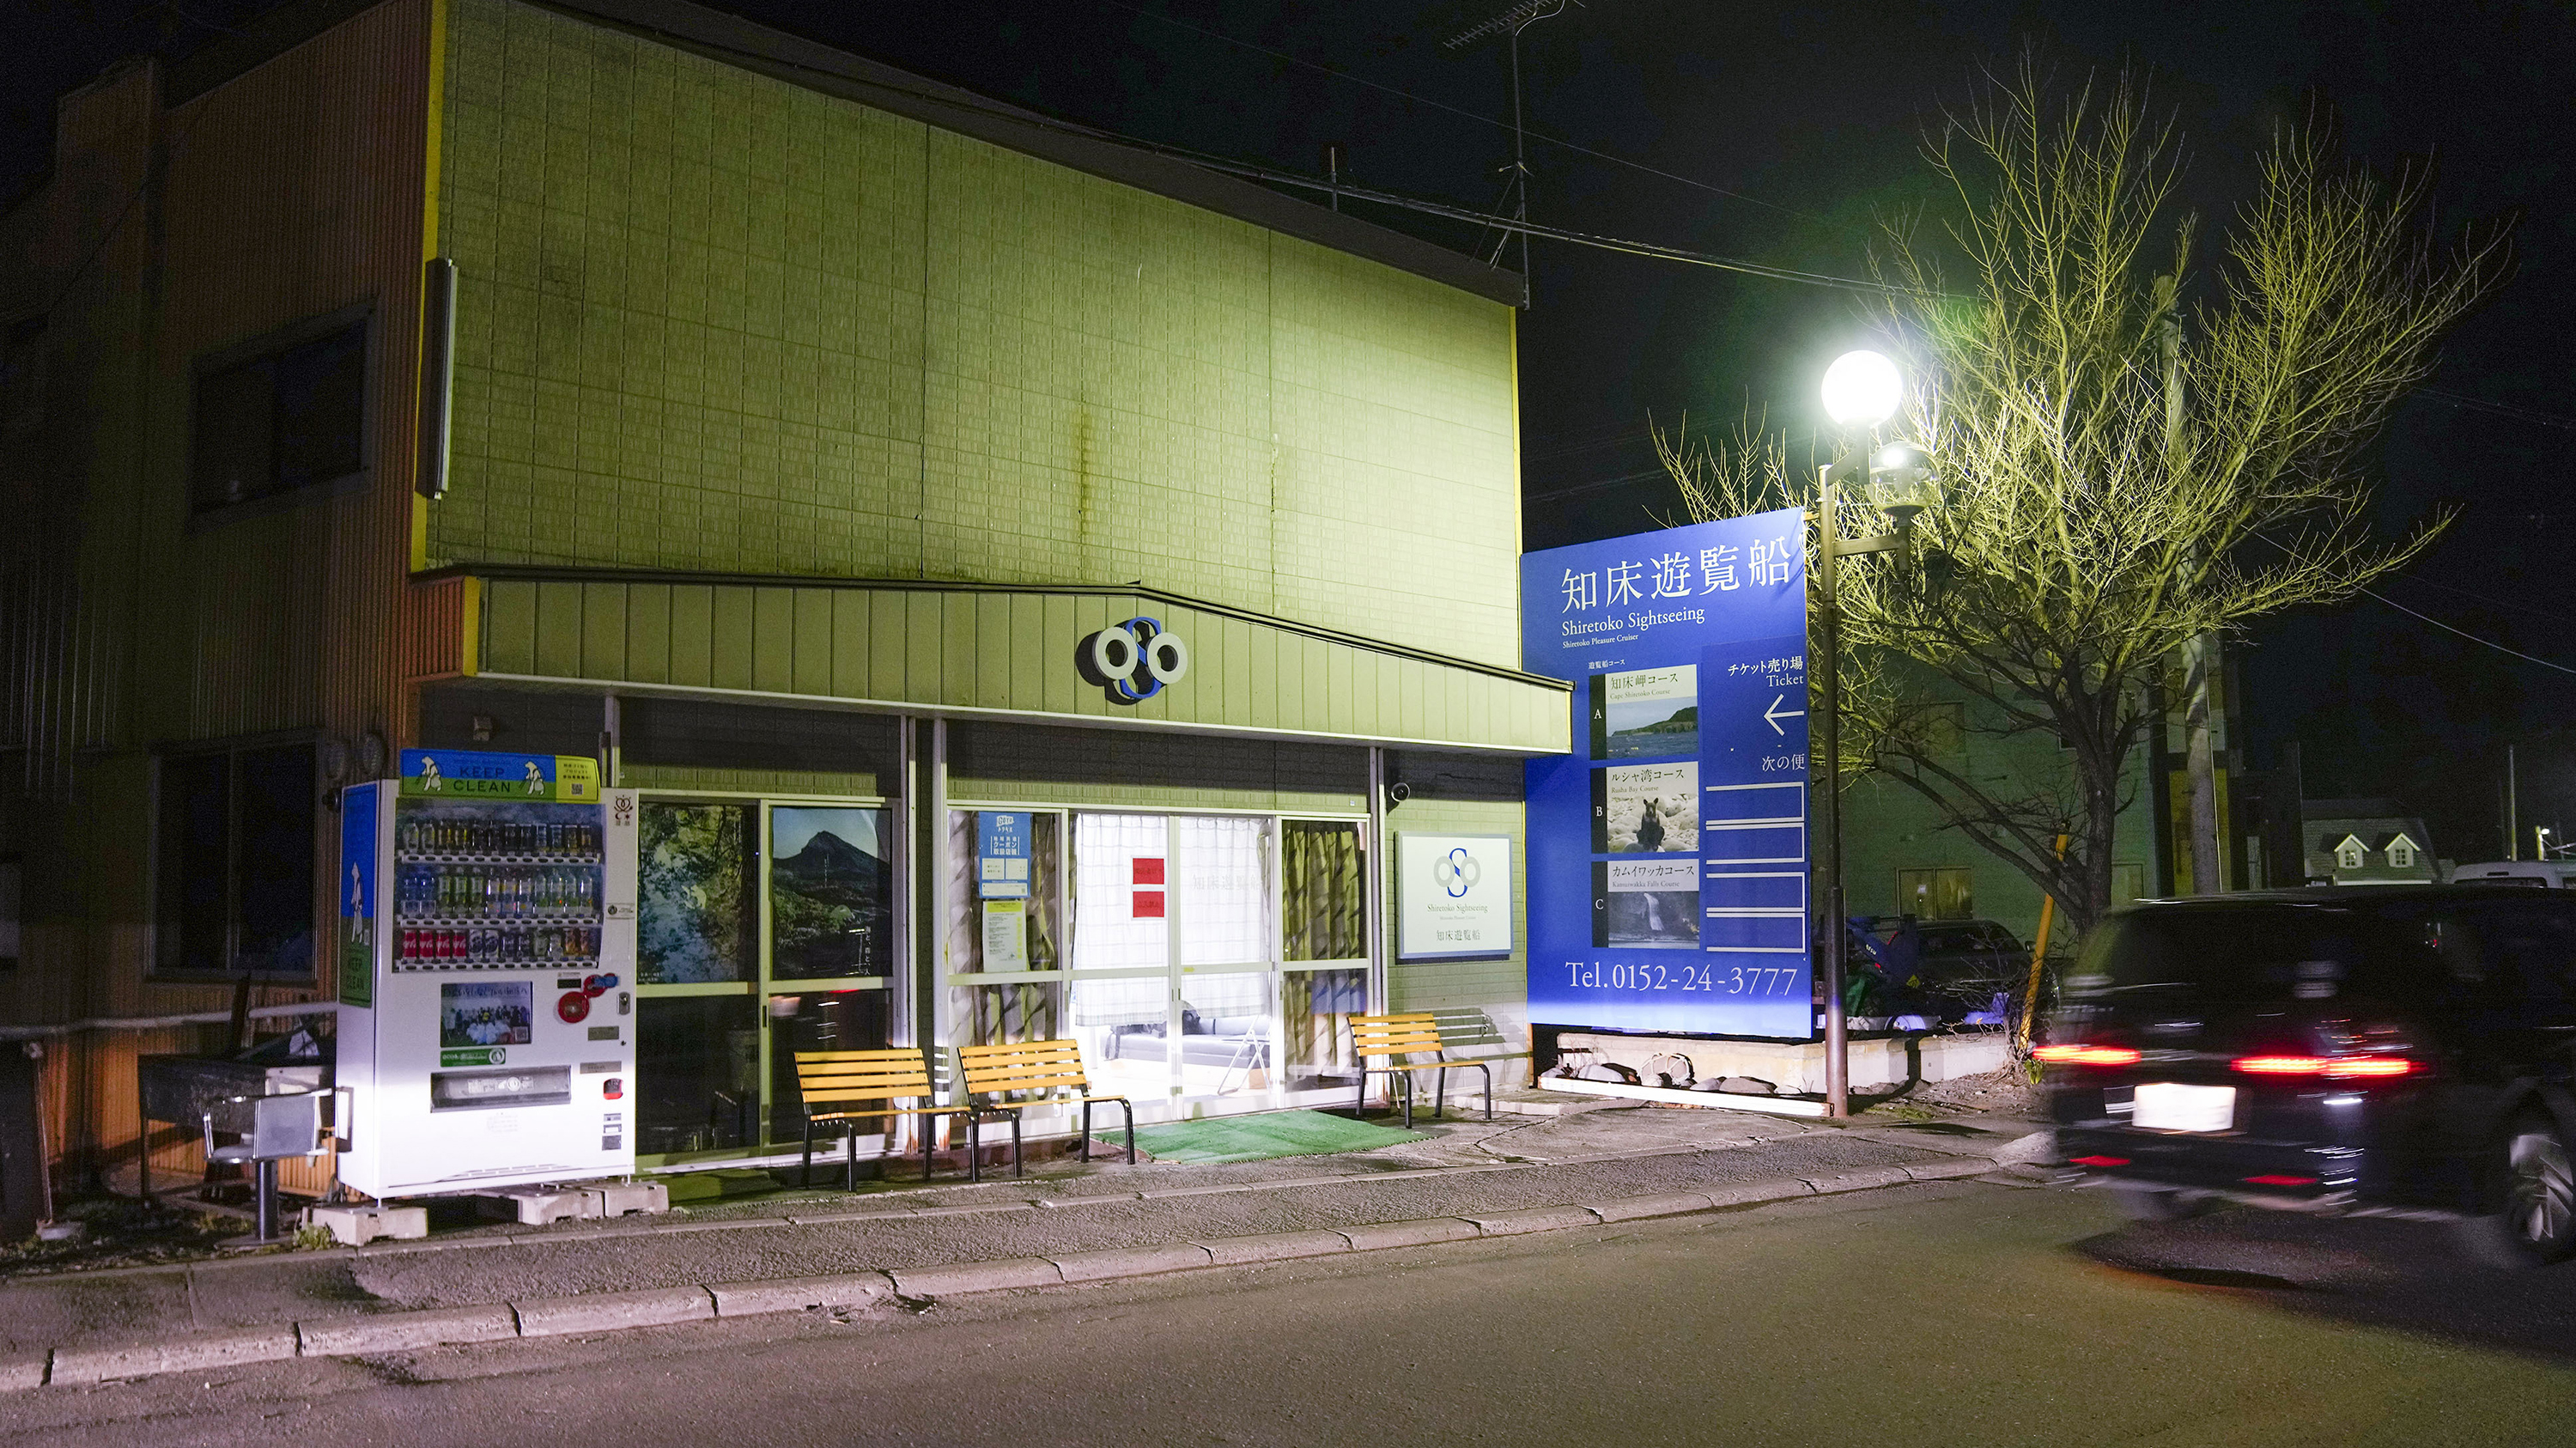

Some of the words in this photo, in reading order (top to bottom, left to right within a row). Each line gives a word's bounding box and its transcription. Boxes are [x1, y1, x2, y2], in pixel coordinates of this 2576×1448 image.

[1561, 535, 1792, 614] 知床遊覧船
[1561, 616, 1624, 636] Shiretoko
[1628, 606, 1705, 631] Sightseeing
[1562, 639, 1590, 649] Shiretoko
[1591, 636, 1615, 645] Pleasure
[1616, 634, 1639, 642] Cruiser
[1728, 655, 1803, 677] チケット売り場
[1611, 673, 1678, 690] 知床岬コース
[1765, 673, 1804, 687] Ticket
[1594, 709, 1602, 719] A
[1762, 753, 1805, 772] 次の便
[459, 765, 505, 778] KEEP
[1612, 769, 1685, 782] ルシャ湾コース
[453, 779, 511, 793] CLEAN
[1628, 786, 1638, 794] Bay
[1596, 806, 1602, 817] B
[1613, 865, 1695, 877] カムイワッカコース
[1427, 903, 1455, 912] Shiretoko
[1456, 903, 1488, 914] Sightseeing
[1595, 898, 1604, 910] C
